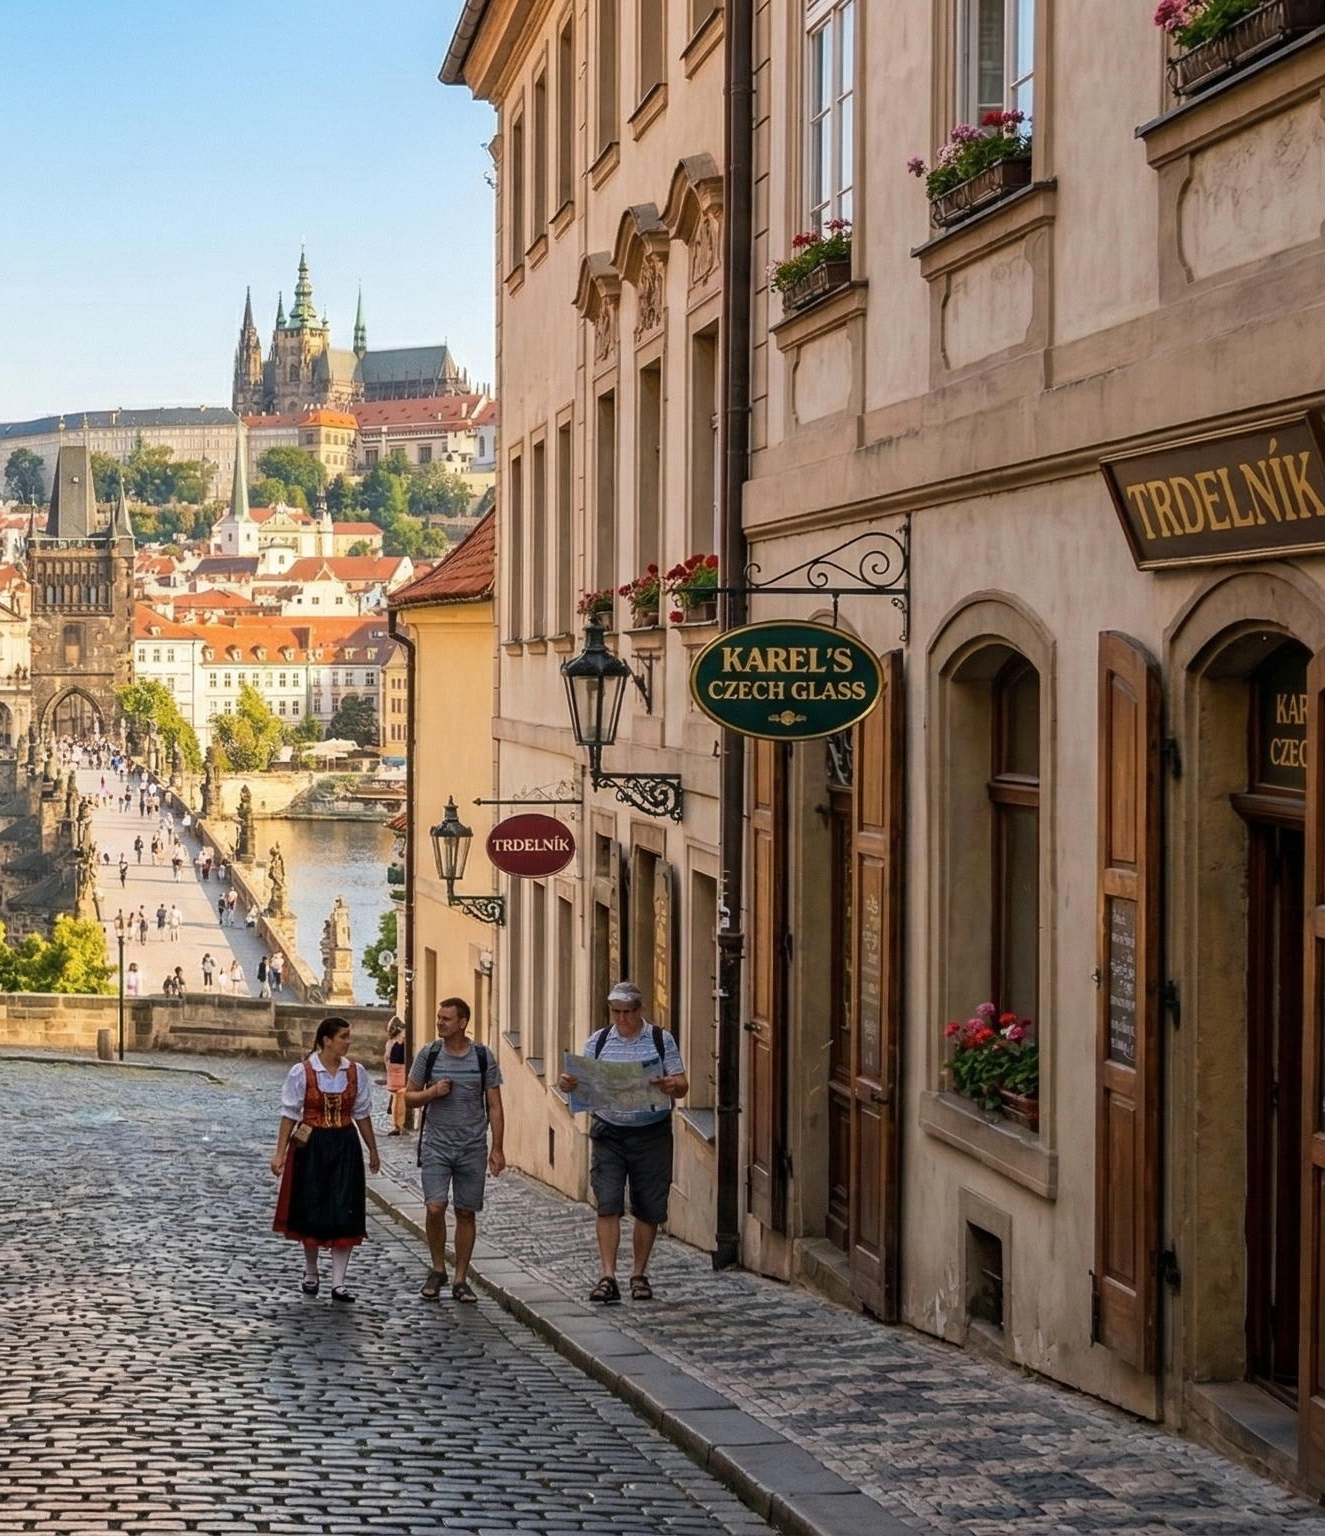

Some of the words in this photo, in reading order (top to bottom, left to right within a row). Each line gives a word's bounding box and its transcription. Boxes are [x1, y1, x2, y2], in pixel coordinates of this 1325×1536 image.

[1126, 437, 1325, 539] TRDELNÍK
[721, 647, 853, 673] KAREL'S
[708, 681, 785, 700] CZECH
[791, 681, 866, 700] GLASS
[492, 835, 570, 851] TRDELNÍK
